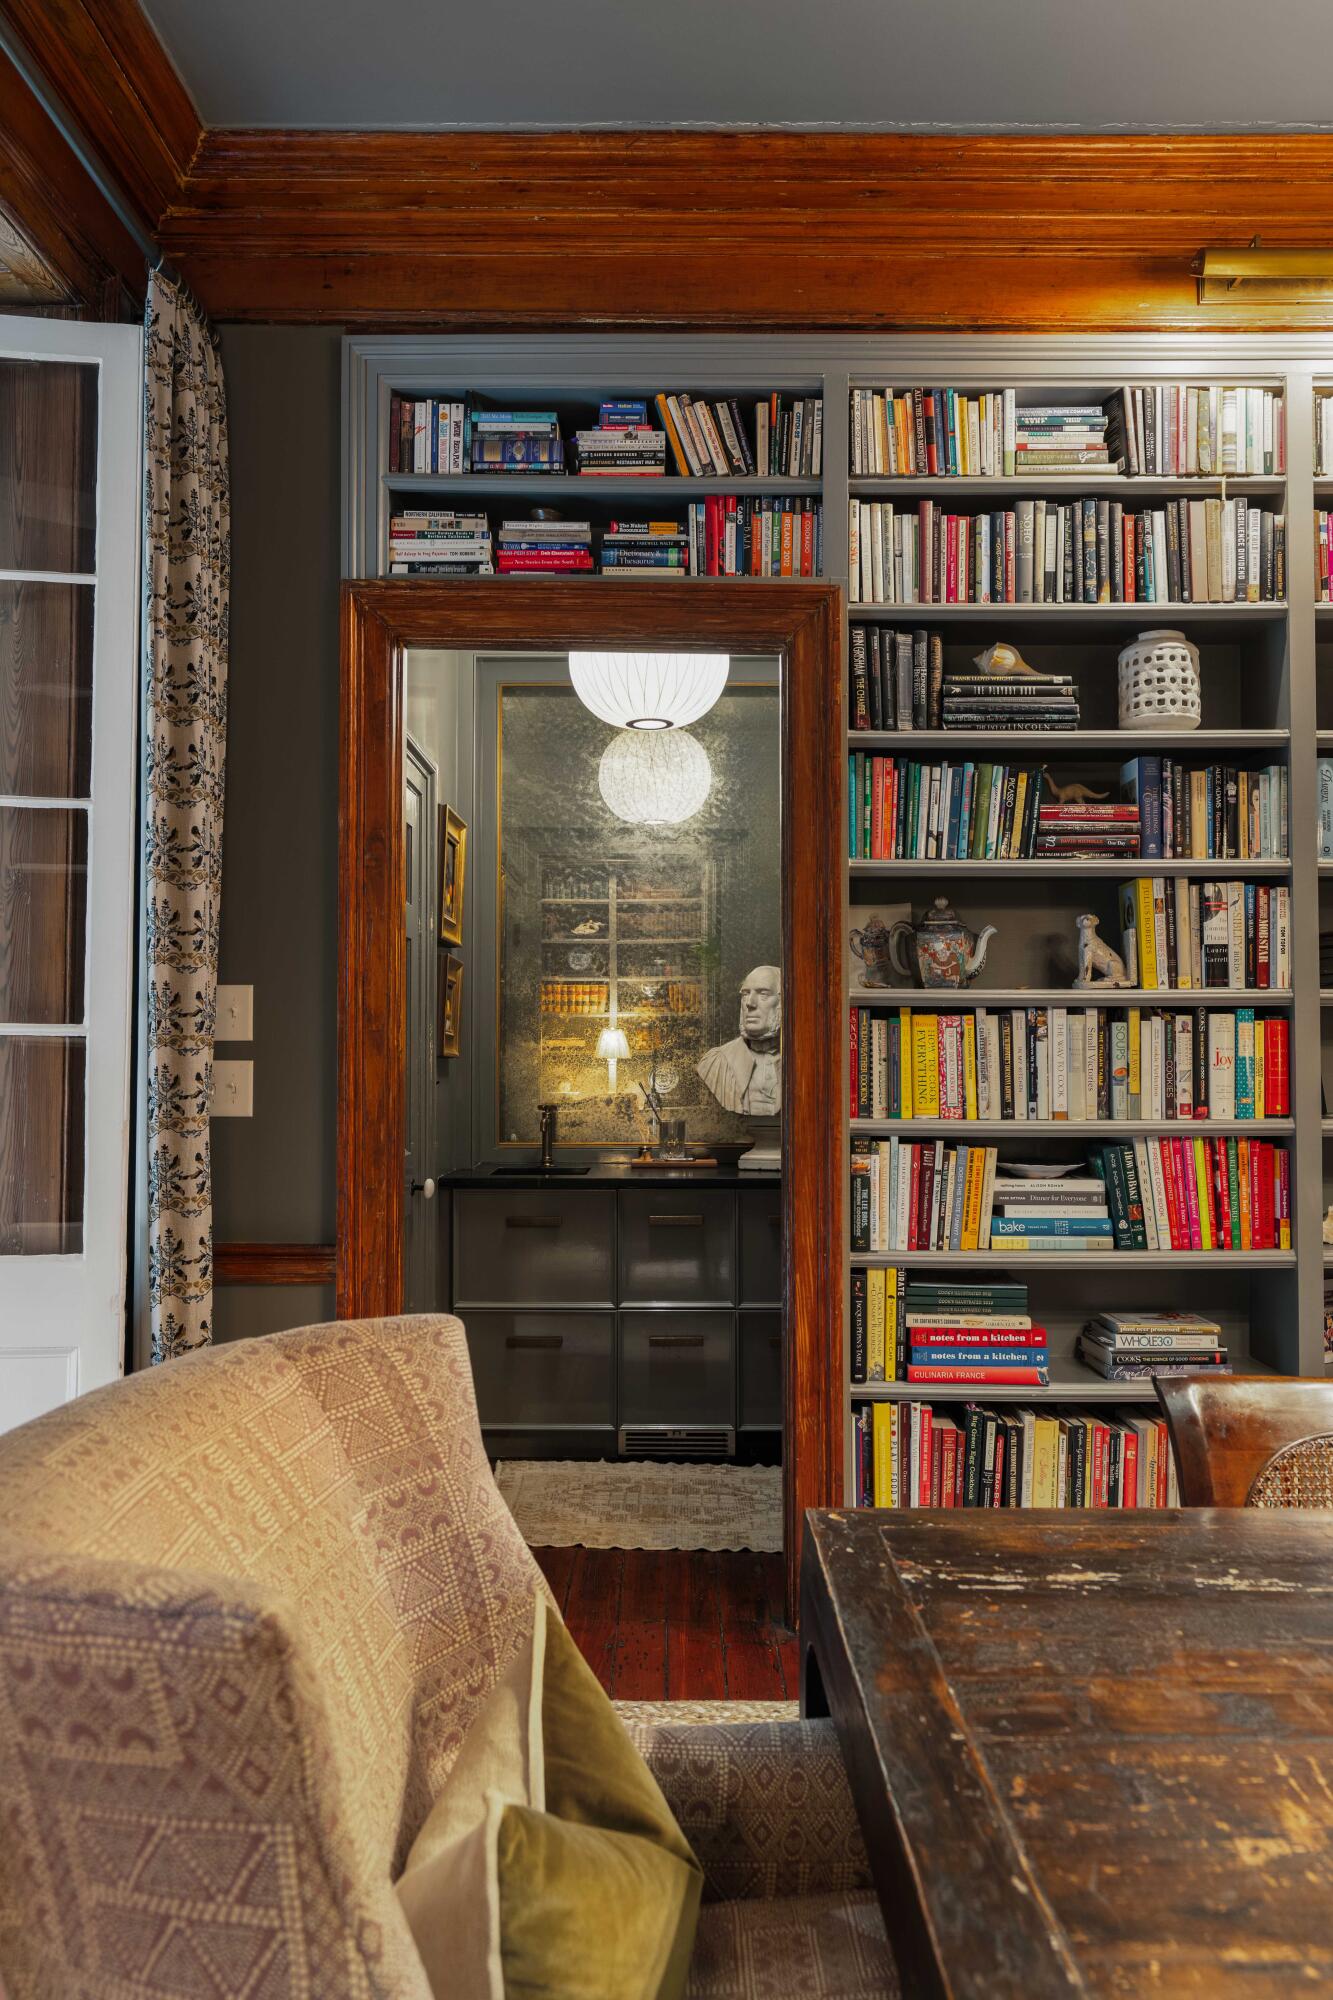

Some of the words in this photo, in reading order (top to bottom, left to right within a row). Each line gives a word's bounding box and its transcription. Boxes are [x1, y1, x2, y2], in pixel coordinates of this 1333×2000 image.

[1023, 514, 1033, 543] SOHO
[1237, 508, 1245, 547] RESILIENCE
[1237, 548, 1245, 580] DIVIDEND
[853, 630, 865, 646] JOHN
[853, 647, 865, 676] GRISHAM
[857, 678, 865, 689] THE
[1020, 687, 1036, 695] BOOK
[857, 690, 866, 715] CHAMBER
[1006, 778, 1016, 807] PICASSO
[1320, 770, 1332, 804] DARWIN
[1142, 887, 1150, 914] JULIUS
[1144, 917, 1152, 954] ROBERTS
[1232, 912, 1242, 949] SIBLEY
[928, 1030, 936, 1051] HOW
[1116, 1025, 1125, 1060] SOUPS
[917, 1030, 927, 1104] EVERYTHING
[928, 1058, 936, 1073] TO
[1057, 1062, 1064, 1072] TO
[929, 1075, 937, 1104] COOK
[1057, 1074, 1065, 1098] COOK
[1124, 1151, 1134, 1168] HOW
[1127, 1170, 1135, 1180] TO
[1060, 1195, 1087, 1203] Everyone
[1129, 1180, 1139, 1201] BAKE
[1230, 1191, 1237, 1200] IN
[1231, 1201, 1239, 1223] PARIS
[999, 1220, 1025, 1233] bake
[930, 1334, 954, 1342] notes
[957, 1334, 980, 1342] from
[990, 1333, 1026, 1342] kitchen
[1120, 1336, 1172, 1347] WHOLE30
[855, 1348, 863, 1367] TABLE
[931, 1352, 956, 1360] notes
[958, 1351, 982, 1360] from
[992, 1351, 1028, 1361] kitchen
[914, 1371, 954, 1379] CULINARIA
[971, 1415, 979, 1427] Big
[969, 1450, 977, 1465] Egg
[968, 1466, 977, 1500] Cookbook
